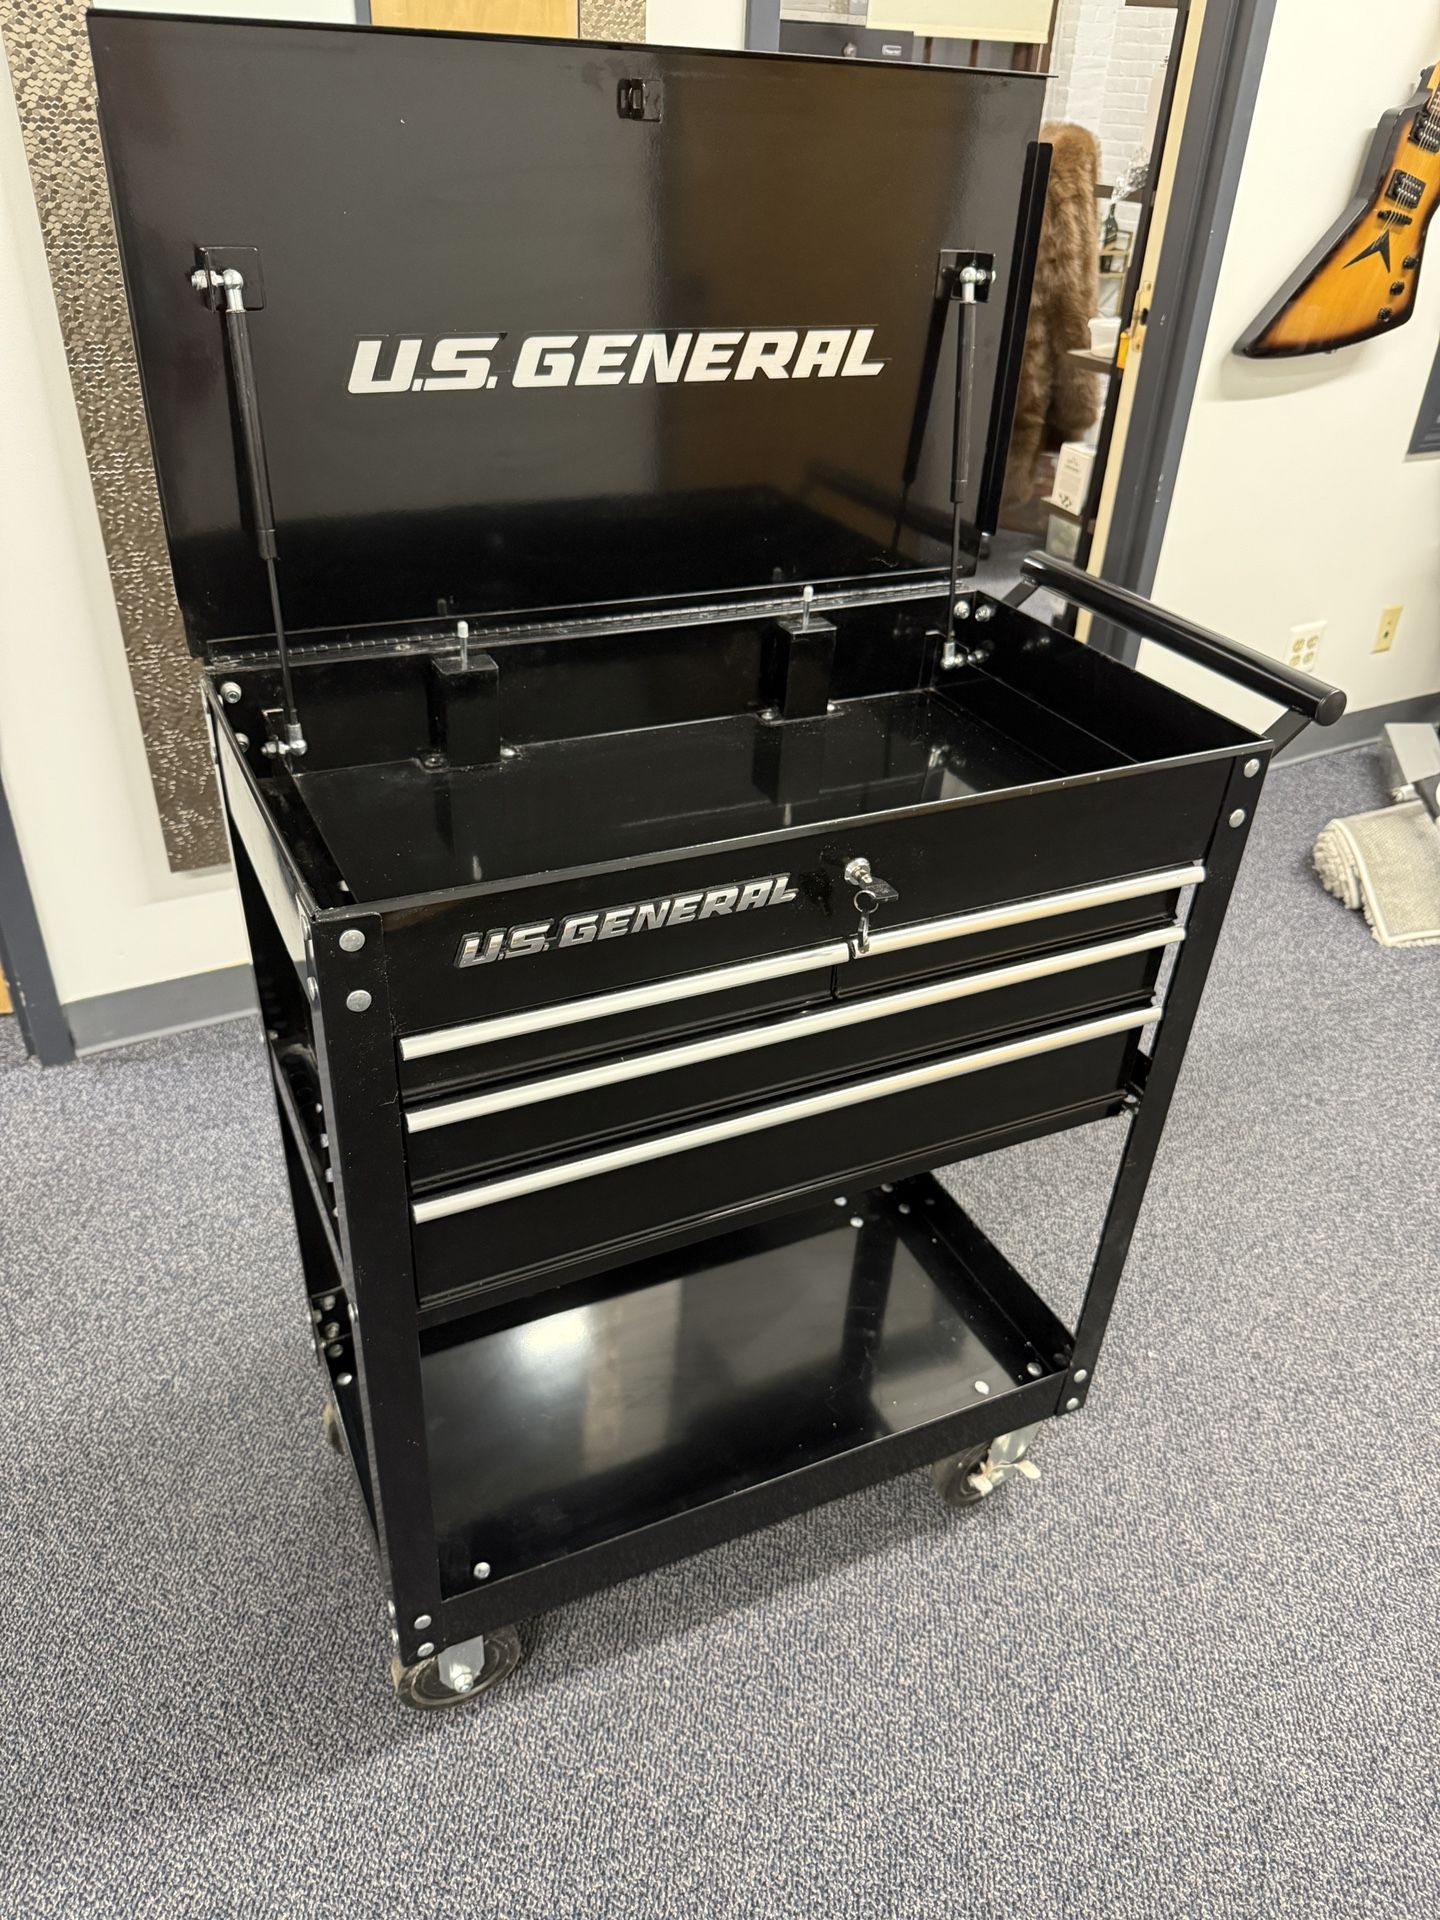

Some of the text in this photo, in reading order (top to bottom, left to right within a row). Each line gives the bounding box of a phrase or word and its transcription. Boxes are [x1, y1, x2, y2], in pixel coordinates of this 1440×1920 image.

[348, 329, 885, 393] U.S. GENERAL
[456, 875, 798, 968] U.S. GENERAL
